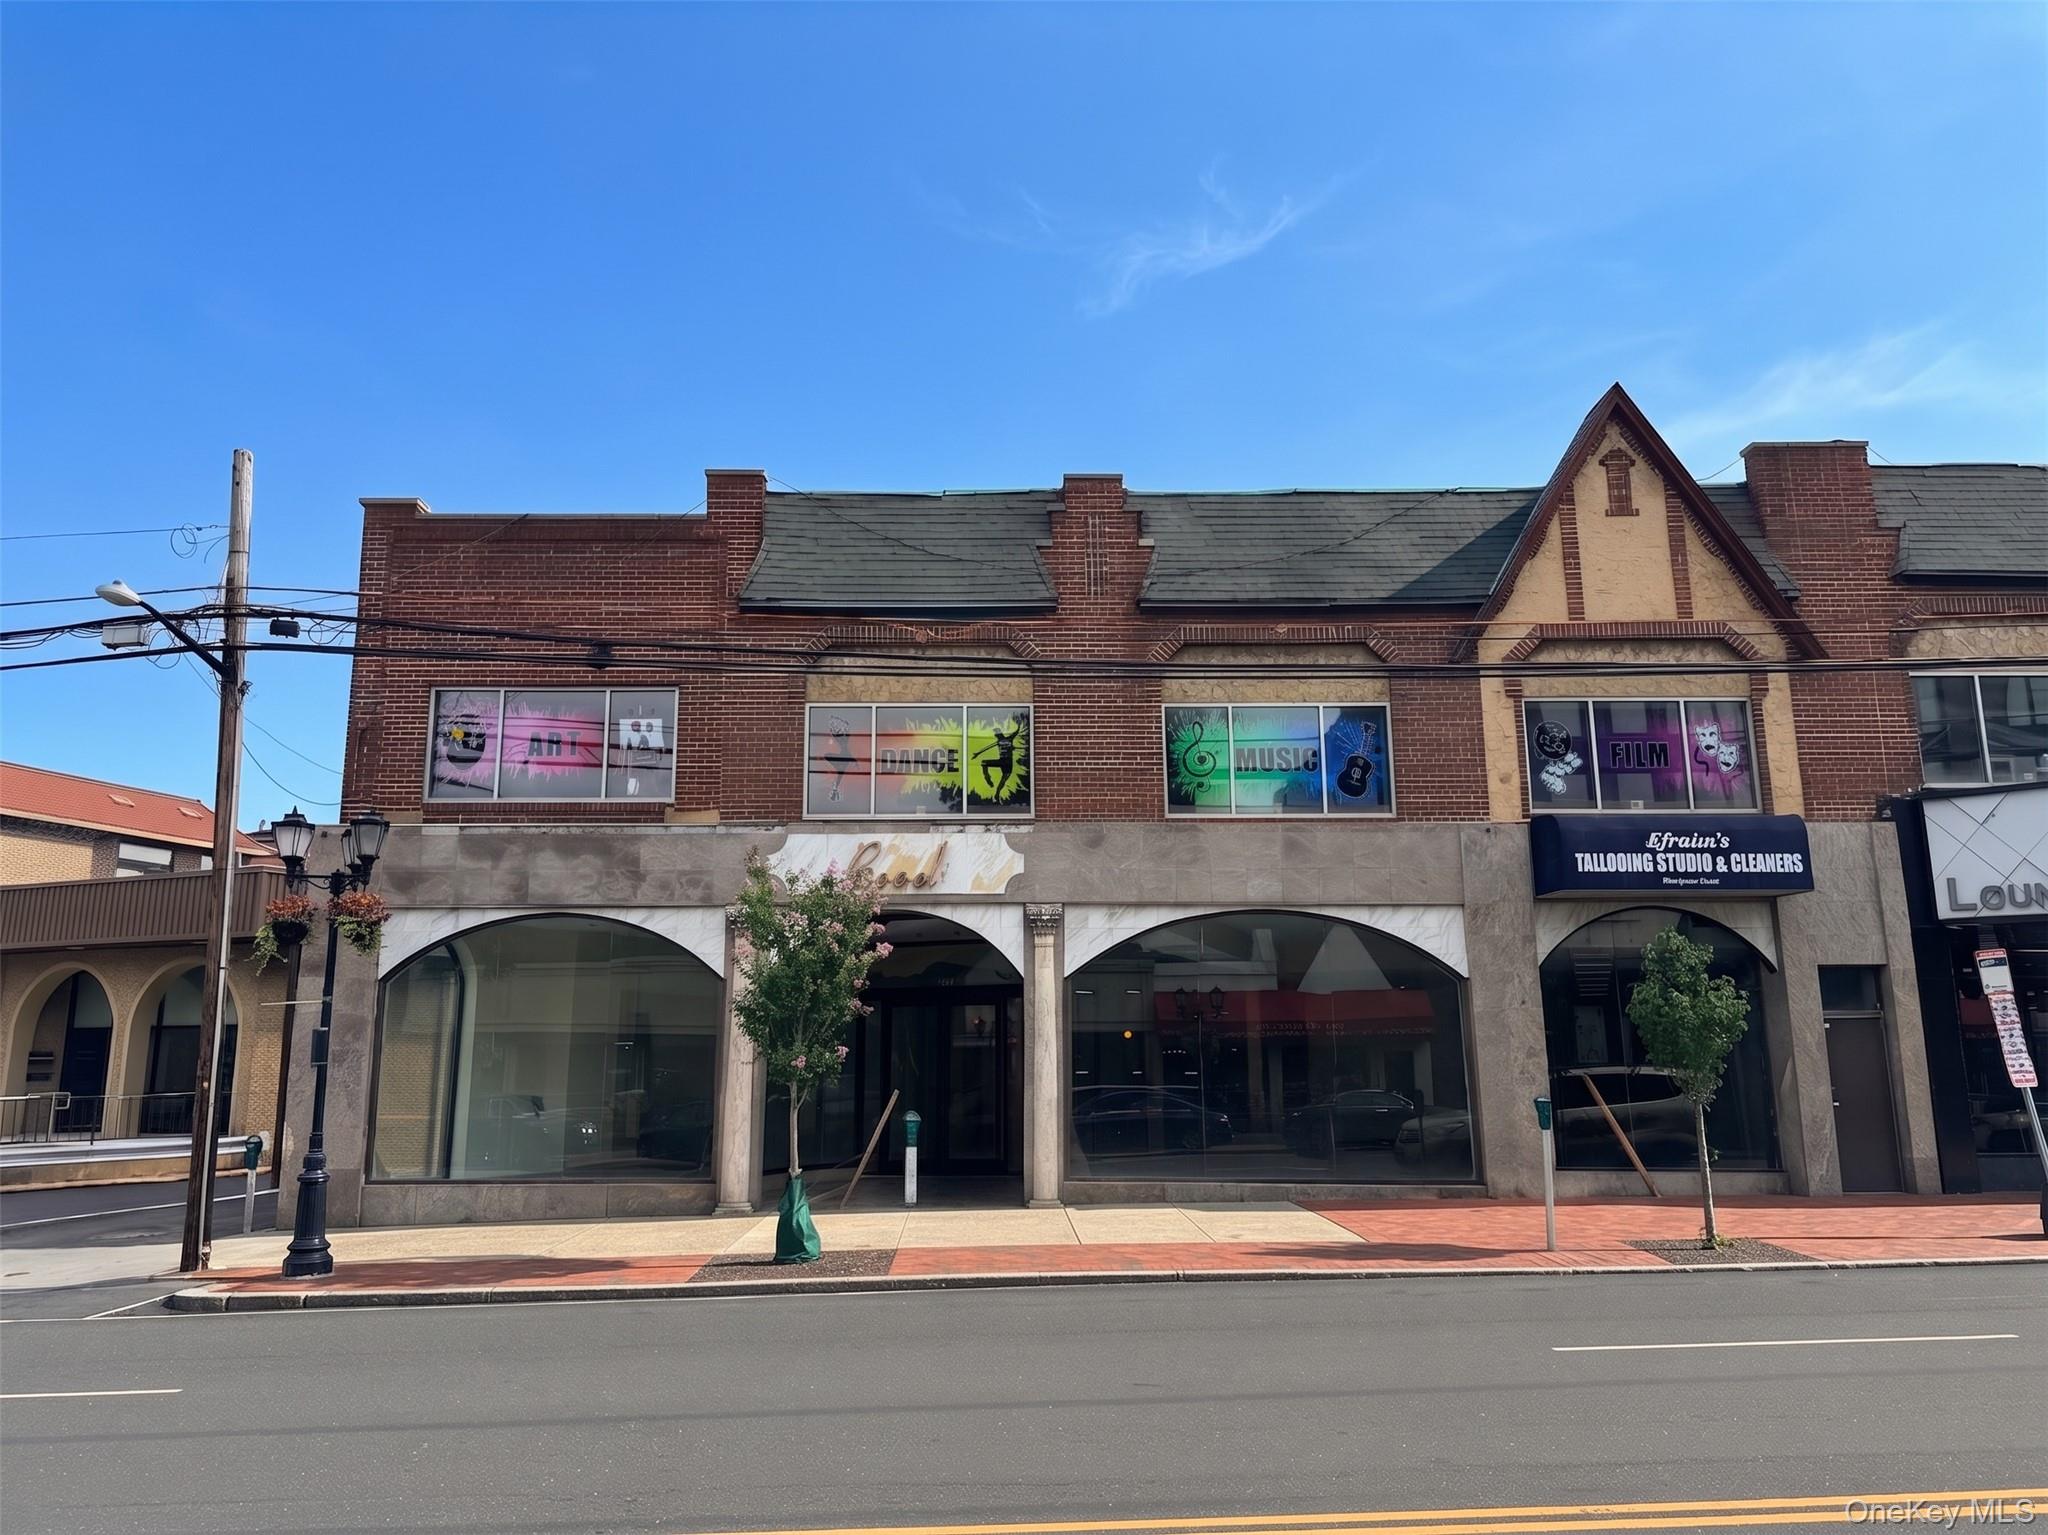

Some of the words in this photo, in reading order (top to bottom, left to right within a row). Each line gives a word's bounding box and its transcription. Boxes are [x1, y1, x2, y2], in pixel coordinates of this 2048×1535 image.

[528, 731, 582, 757] ART
[1609, 741, 1670, 769] FILM
[879, 747, 960, 774] DANCE
[1235, 746, 1319, 773] MUSIC
[1656, 853, 1713, 873] STUDIO
[1716, 856, 1728, 873] &
[1730, 853, 1804, 873] CLEANERS
